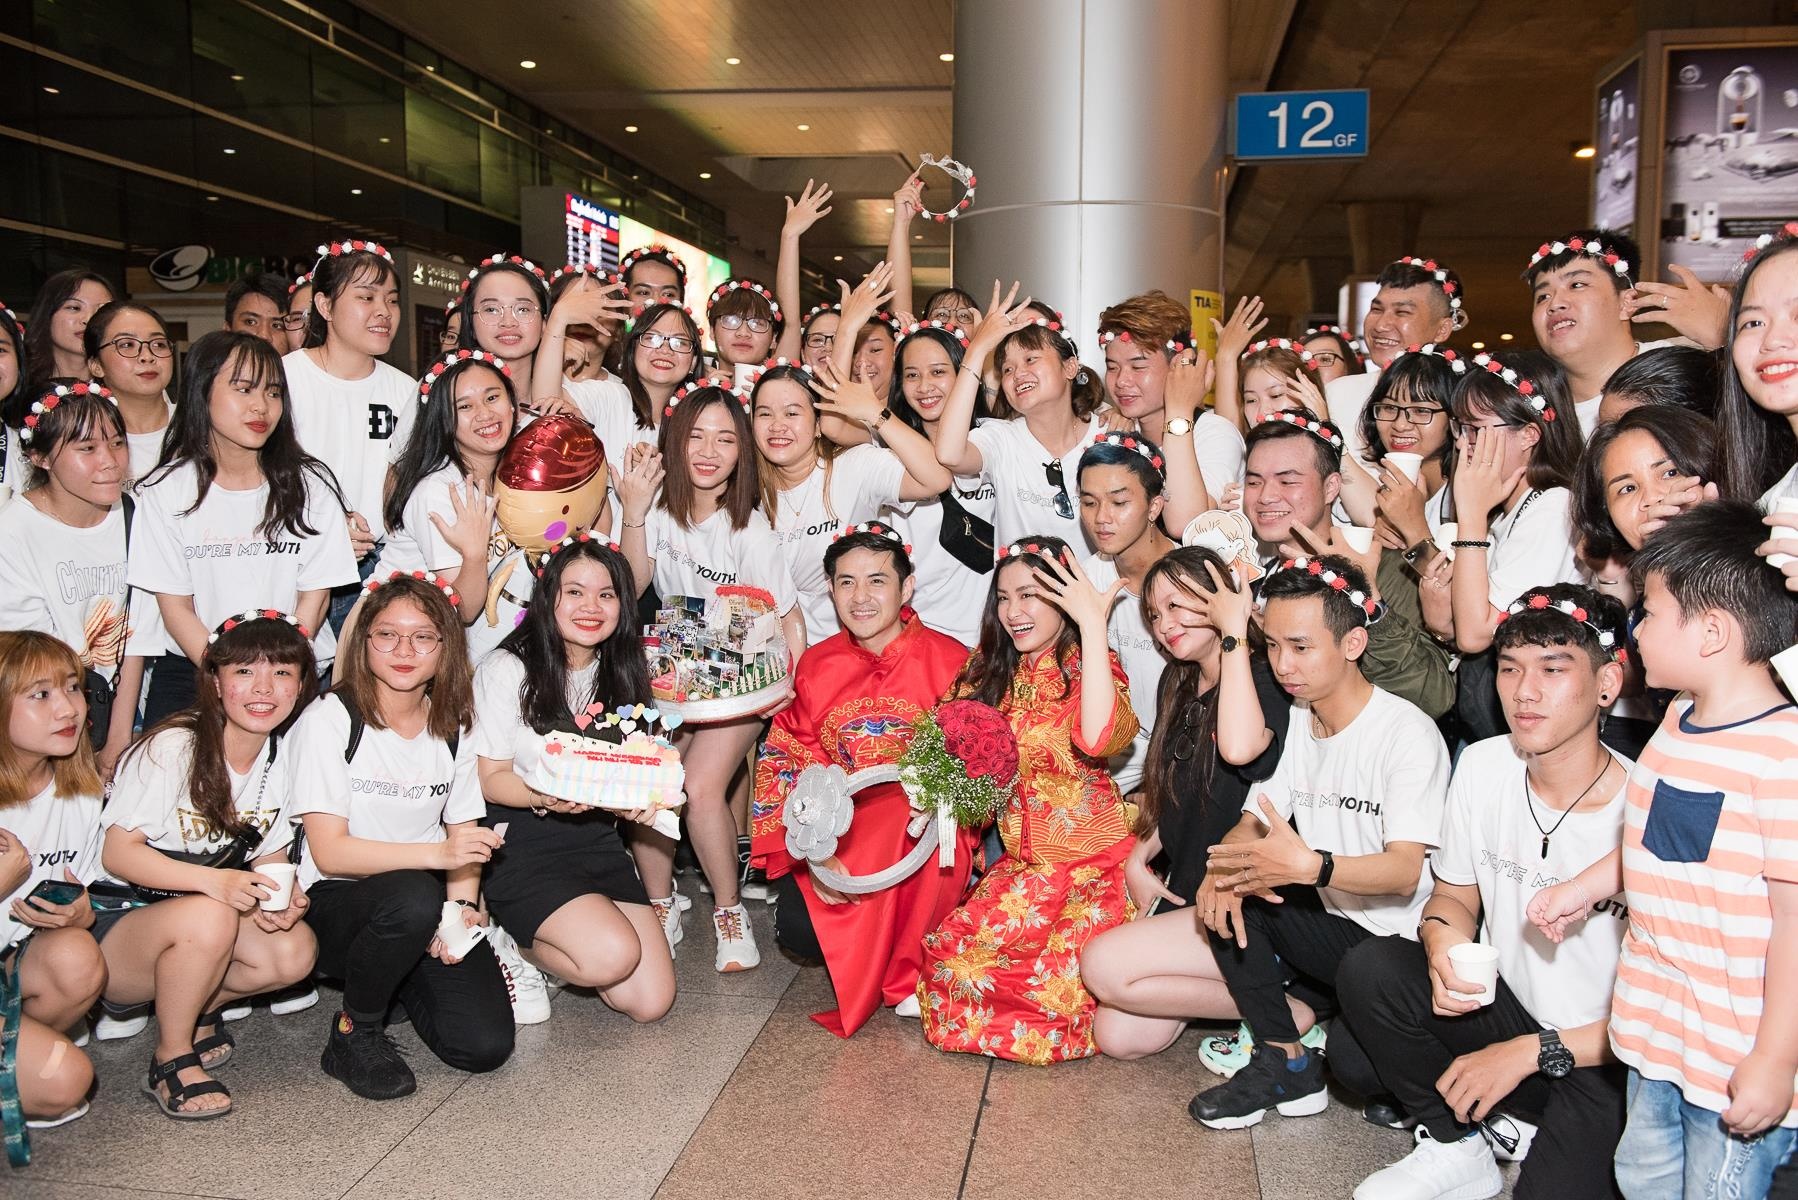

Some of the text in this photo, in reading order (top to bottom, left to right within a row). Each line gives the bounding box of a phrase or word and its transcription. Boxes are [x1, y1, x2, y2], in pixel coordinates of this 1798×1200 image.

[1268, 101, 1357, 148] 12 GF
[184, 544, 232, 559] OU'RE
[238, 542, 261, 556] MY
[697, 565, 736, 583] YOUTH
[352, 778, 399, 796] OU'RE
